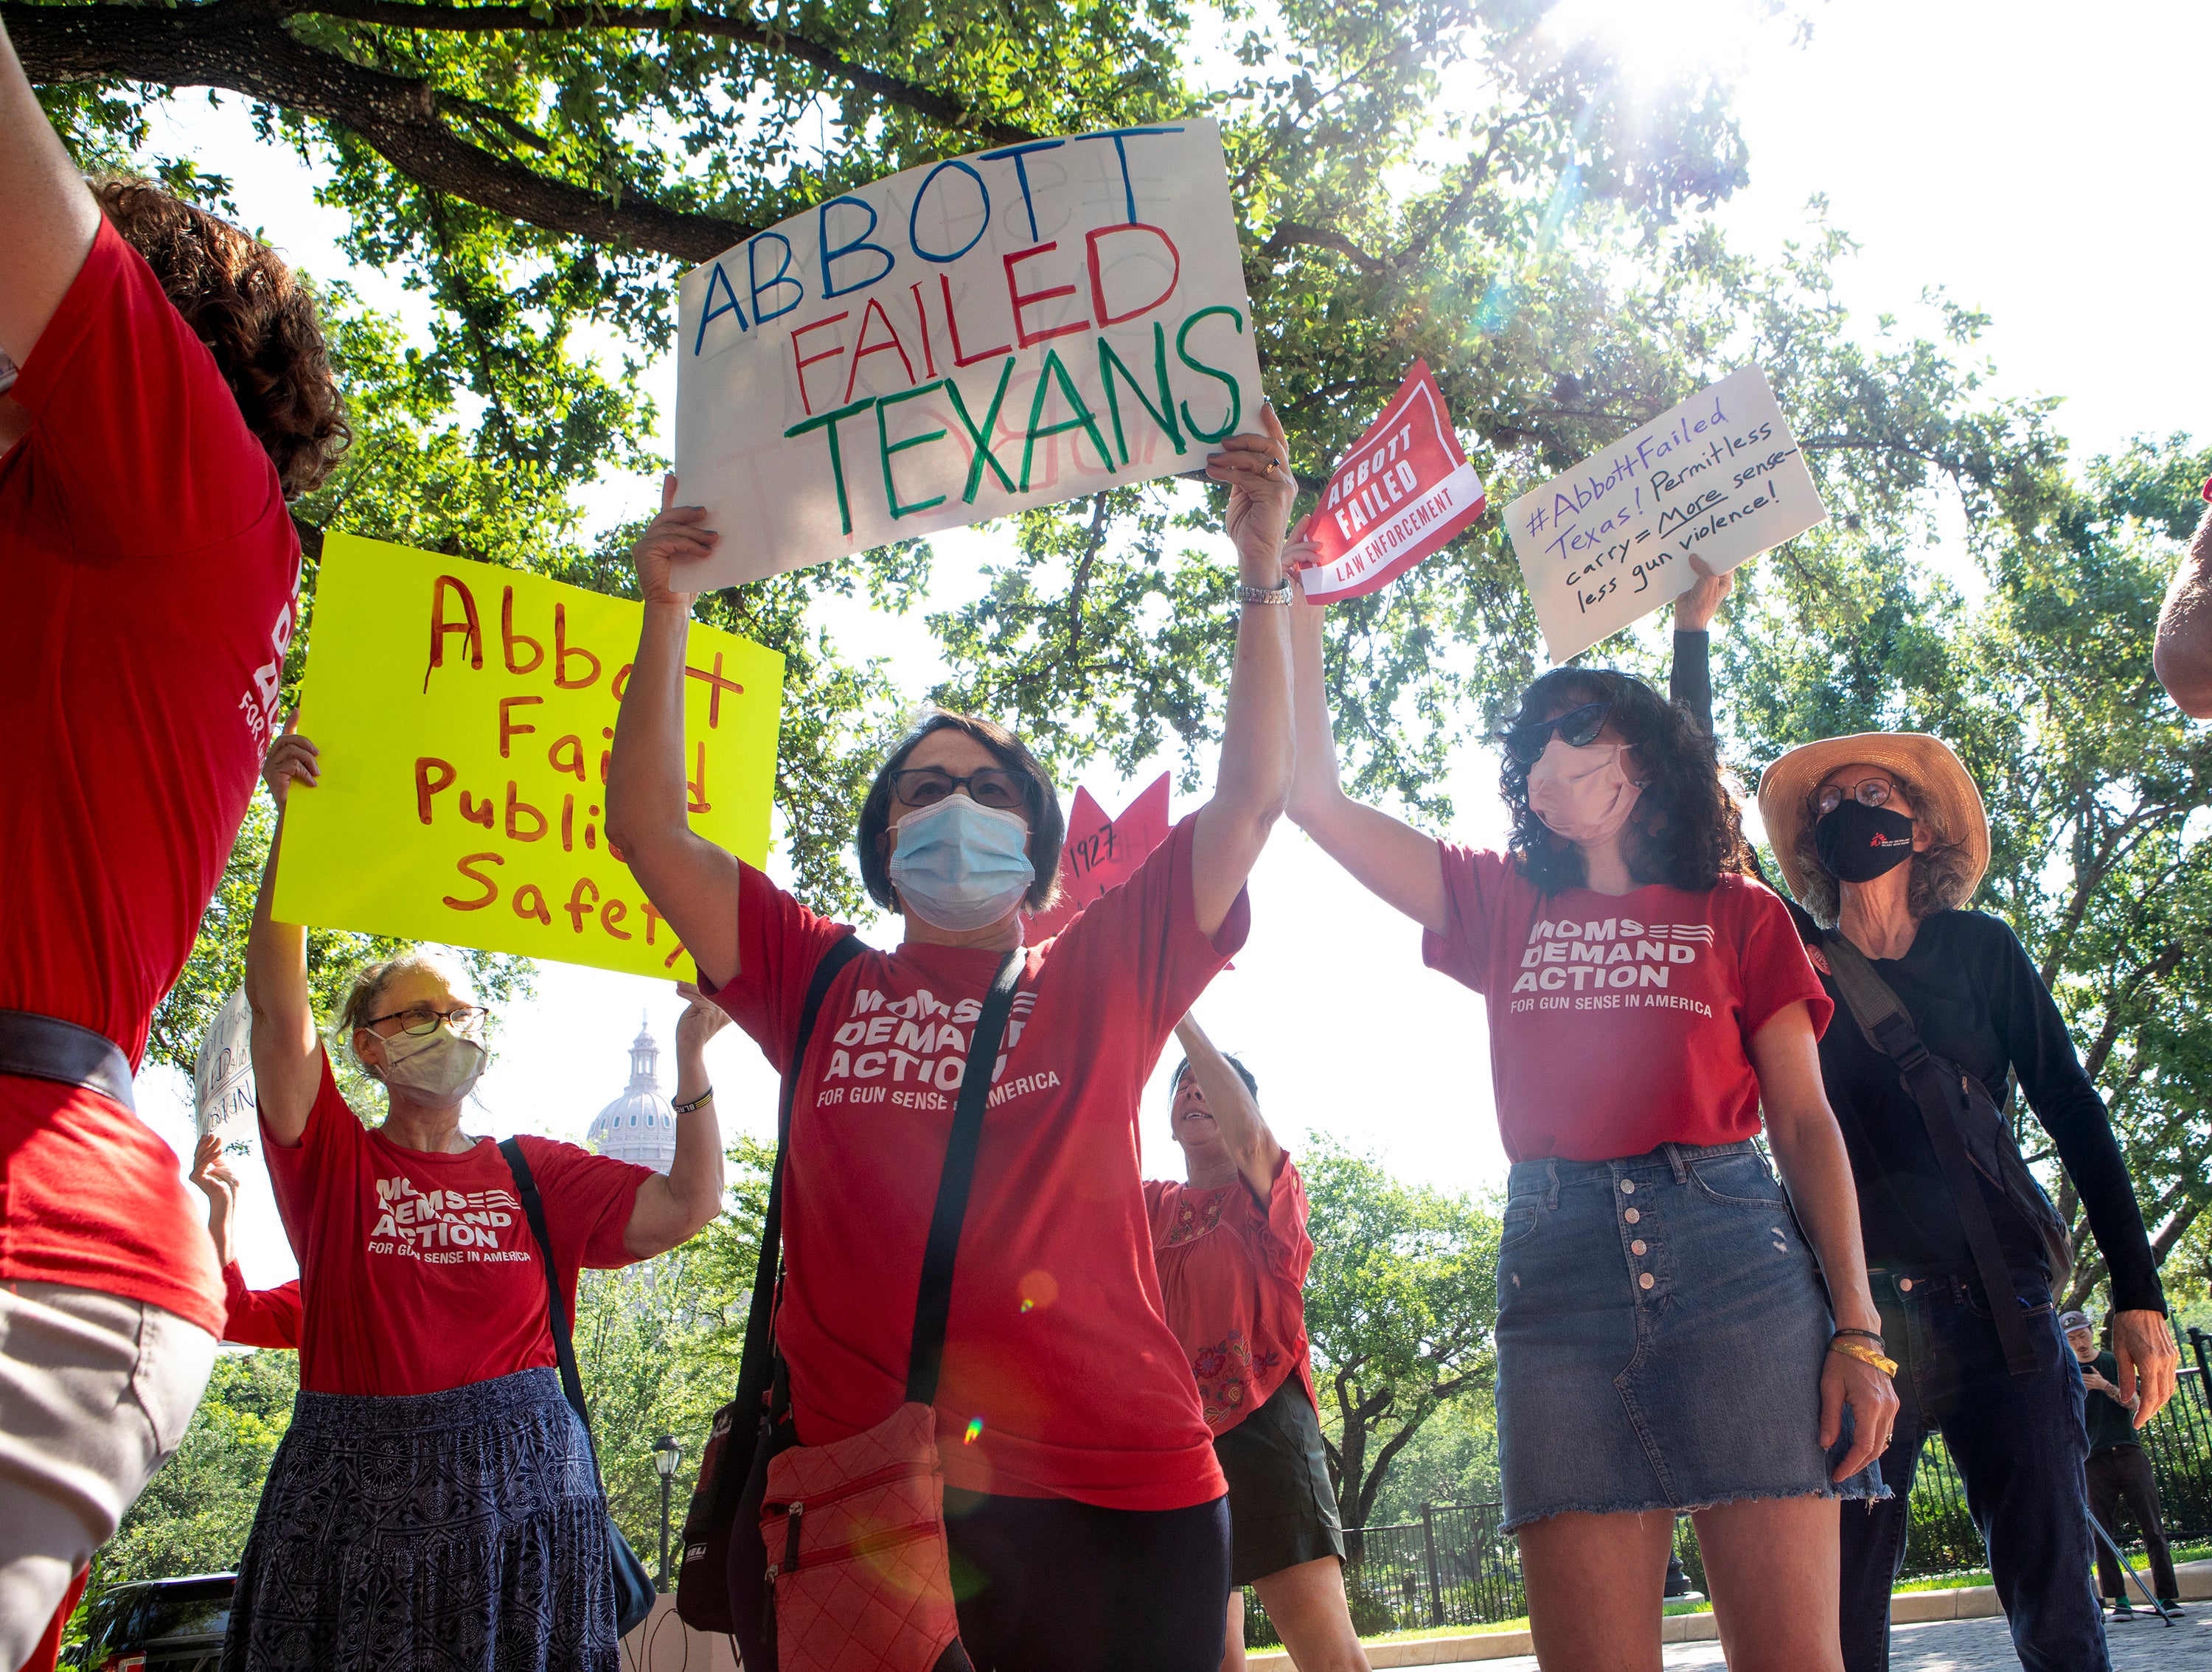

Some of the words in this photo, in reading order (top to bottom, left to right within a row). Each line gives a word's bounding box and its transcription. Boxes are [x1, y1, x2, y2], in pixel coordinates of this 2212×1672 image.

[695, 127, 1185, 356] ABBOTT
[791, 223, 1180, 415] FAILED
[785, 306, 1243, 535] TEXANS
[1327, 423, 1411, 511] ABBOTT
[1526, 397, 1729, 537] #AbbottFailed
[1650, 422, 1772, 501] Permitless
[1335, 459, 1417, 540] FAILED
[1658, 489, 1722, 534] More
[1335, 557, 1365, 582] LAW
[1365, 487, 1453, 565] ENFORCEMENT
[1577, 577, 1617, 613] less
[1632, 553, 1673, 593] gun
[1679, 480, 1779, 551] violence!
[238, 689, 265, 742] FOR
[499, 695, 712, 813] Faid
[1070, 823, 1117, 879] 1927
[1520, 940, 1696, 968] DEMAND
[1528, 918, 1644, 944] MOMS
[850, 989, 984, 1023] MOMS
[1511, 997, 1534, 1014] FOR
[1540, 997, 1570, 1010] GUN
[1575, 995, 1621, 1010] SENSE
[1625, 995, 1640, 1007] IN
[1644, 995, 1712, 1018] AMERICA
[1512, 964, 1669, 993] ACTION
[816, 1087, 844, 1107] FOR
[849, 1087, 886, 1103] GUN
[891, 1091, 948, 1110] SENSE
[367, 1241, 393, 1255] FOR
[424, 1251, 464, 1264] SENSE
[467, 1250, 480, 1261] IN
[483, 1250, 531, 1262] AMERICA
[370, 1213, 498, 1249] ACTION
